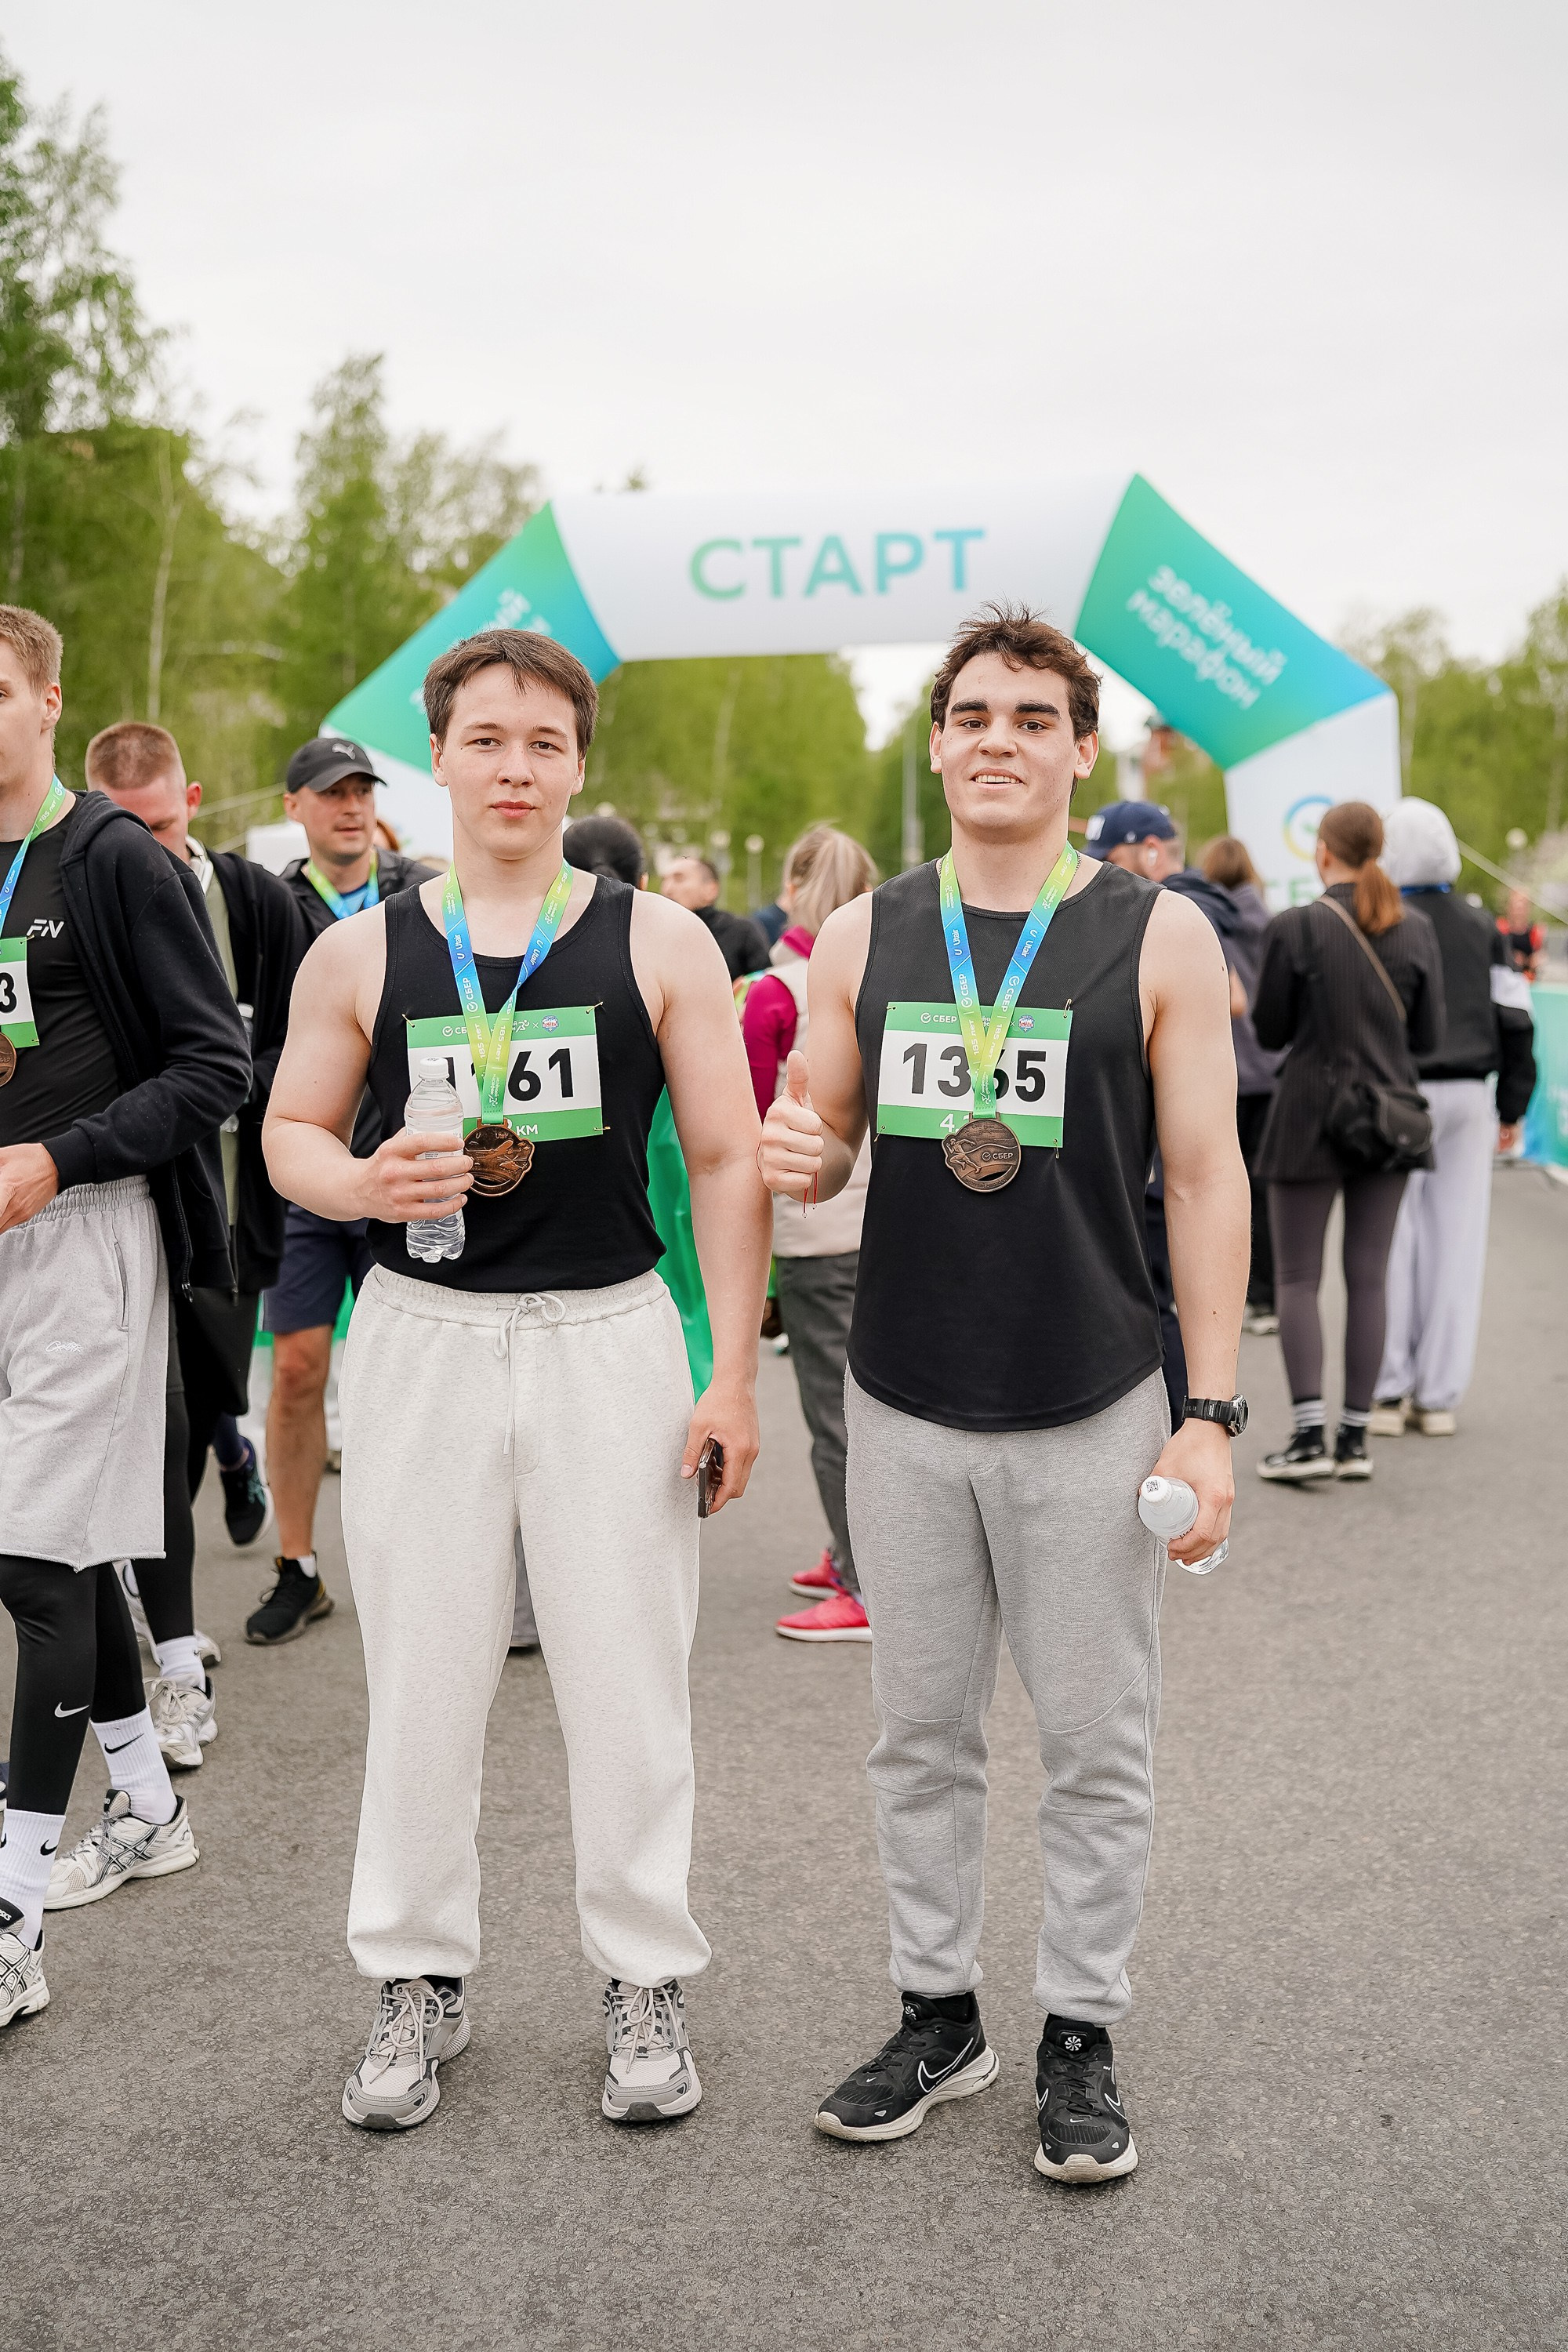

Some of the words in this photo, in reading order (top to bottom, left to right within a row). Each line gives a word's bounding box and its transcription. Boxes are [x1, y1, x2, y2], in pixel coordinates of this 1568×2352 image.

[689, 528, 985, 600] СТАРТ
[453, 934, 463, 950] Utair
[951, 929, 960, 946] Utair
[1022, 940, 1034, 957] Utair
[531, 949, 540, 966] Utair
[463, 977, 474, 1000] СБЕР
[959, 974, 969, 996] СБЕР
[1001, 988, 1014, 1012] СБЕР
[933, 1014, 957, 1024] СБЕР
[993, 1023, 1002, 1040] 185
[442, 1047, 574, 1102] 61
